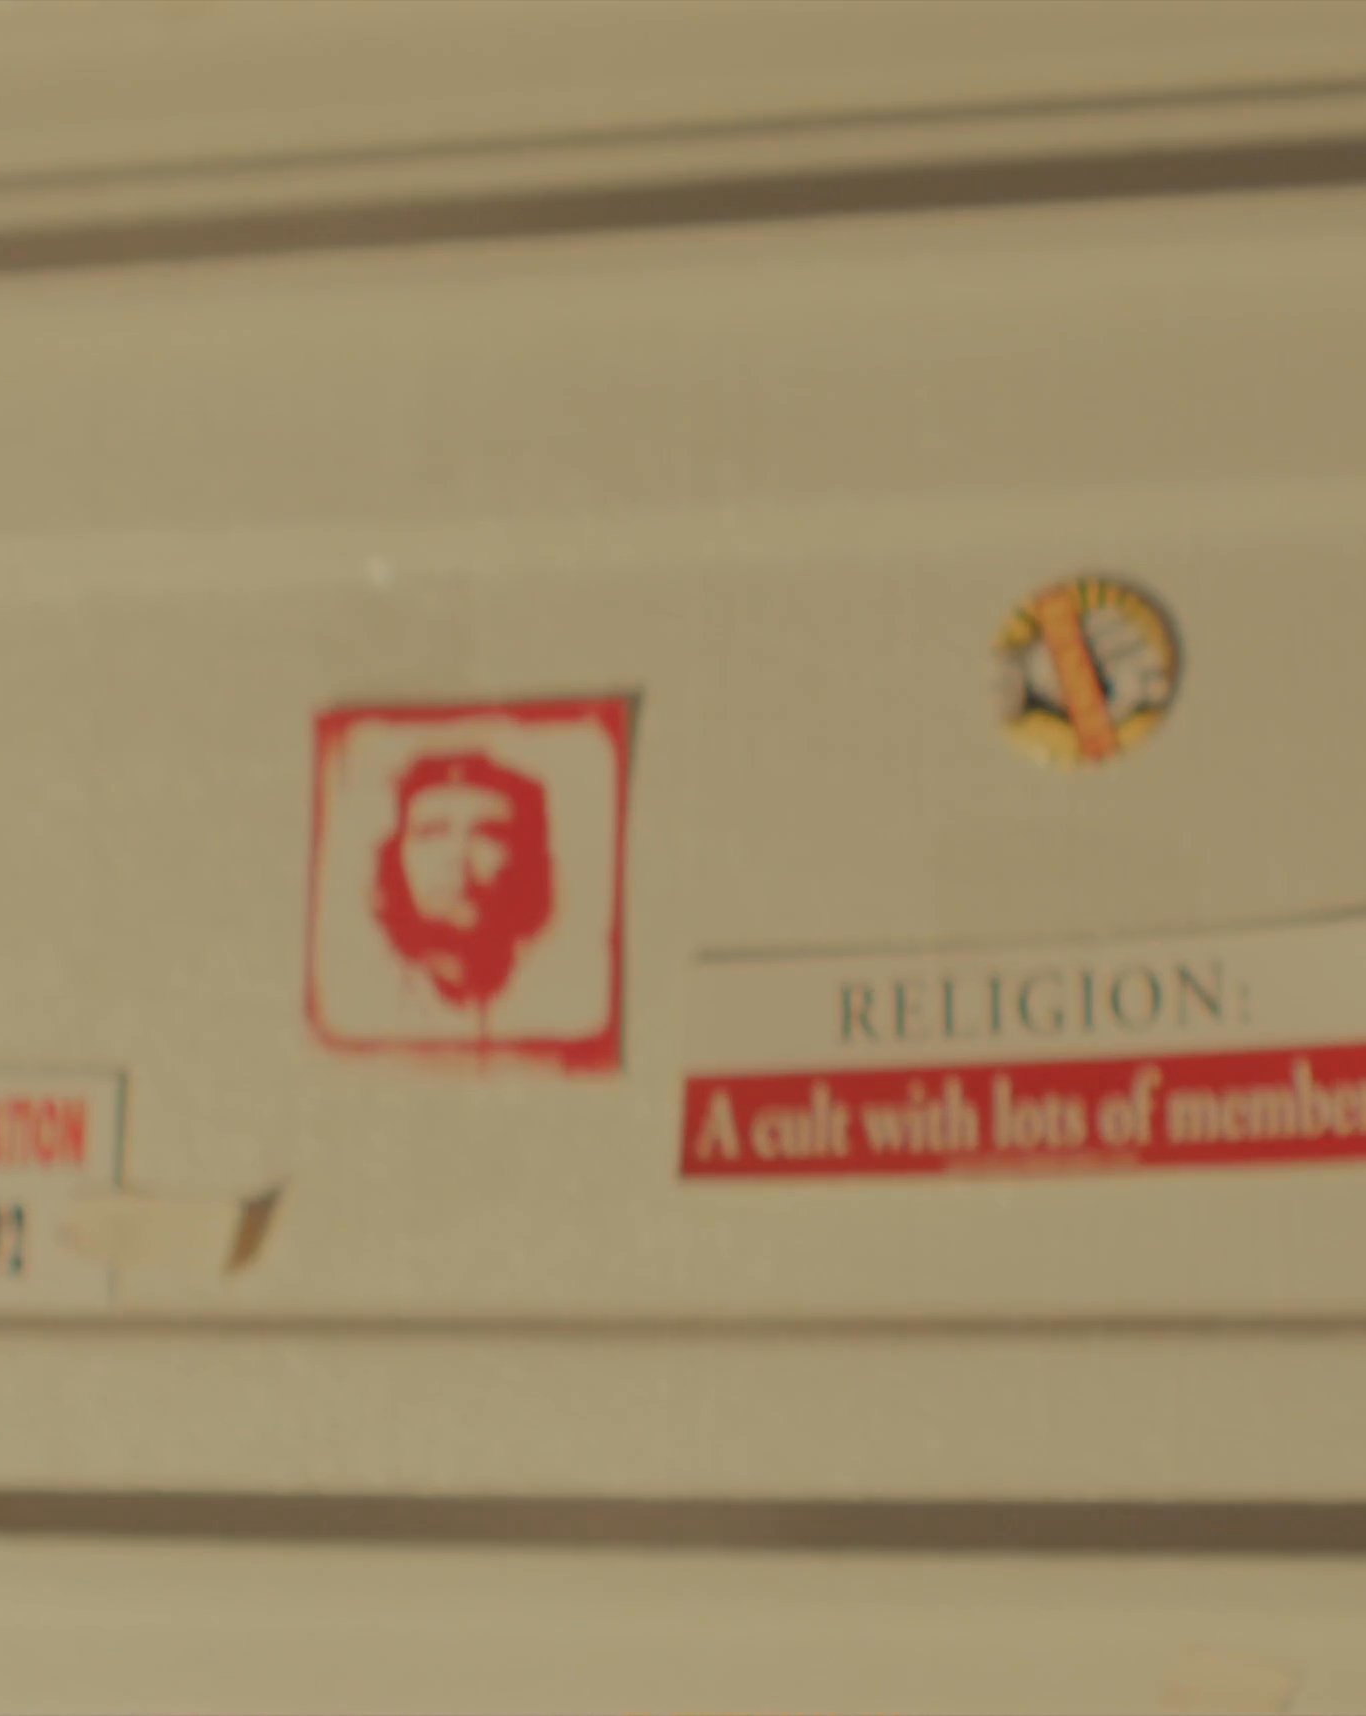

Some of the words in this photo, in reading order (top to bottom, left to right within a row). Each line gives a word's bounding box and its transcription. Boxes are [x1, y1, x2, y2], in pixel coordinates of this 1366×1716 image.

[697, 1087, 740, 1160] A
[752, 1078, 851, 1158] cult
[862, 1075, 980, 1154] with
[993, 1070, 1087, 1150] lots
[1098, 1062, 1162, 1148] of
